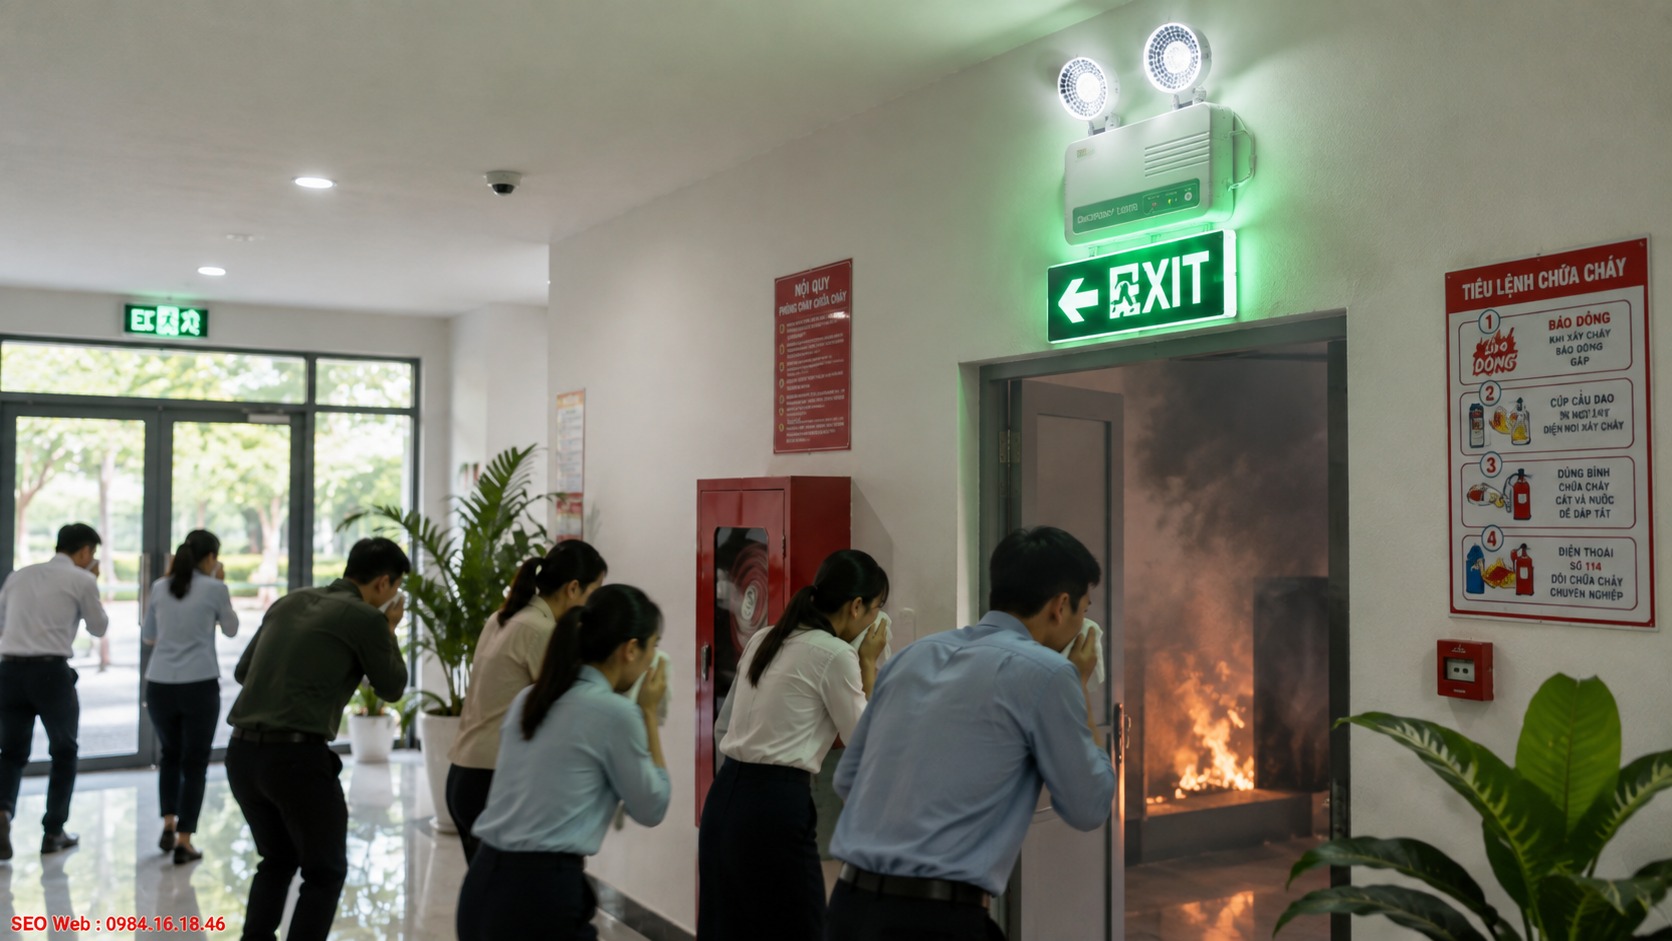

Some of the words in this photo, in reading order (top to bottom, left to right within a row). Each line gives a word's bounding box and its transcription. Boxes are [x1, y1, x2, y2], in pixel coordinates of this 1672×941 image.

[1109, 250, 1210, 320] EXIT
[1461, 276, 1493, 301] TIÊU
[1496, 273, 1534, 299] LỆNH
[1583, 254, 1627, 282] CHÁY
[794, 278, 810, 298] NỘI
[811, 275, 830, 295] QUY
[1484, 314, 1493, 330] 1
[1549, 335, 1564, 344] KHI
[1485, 385, 1495, 401] 2
[1594, 393, 1615, 404] DAO
[1486, 457, 1496, 473] 3
[1486, 530, 1497, 546] 4
[1585, 562, 1602, 571] 114
